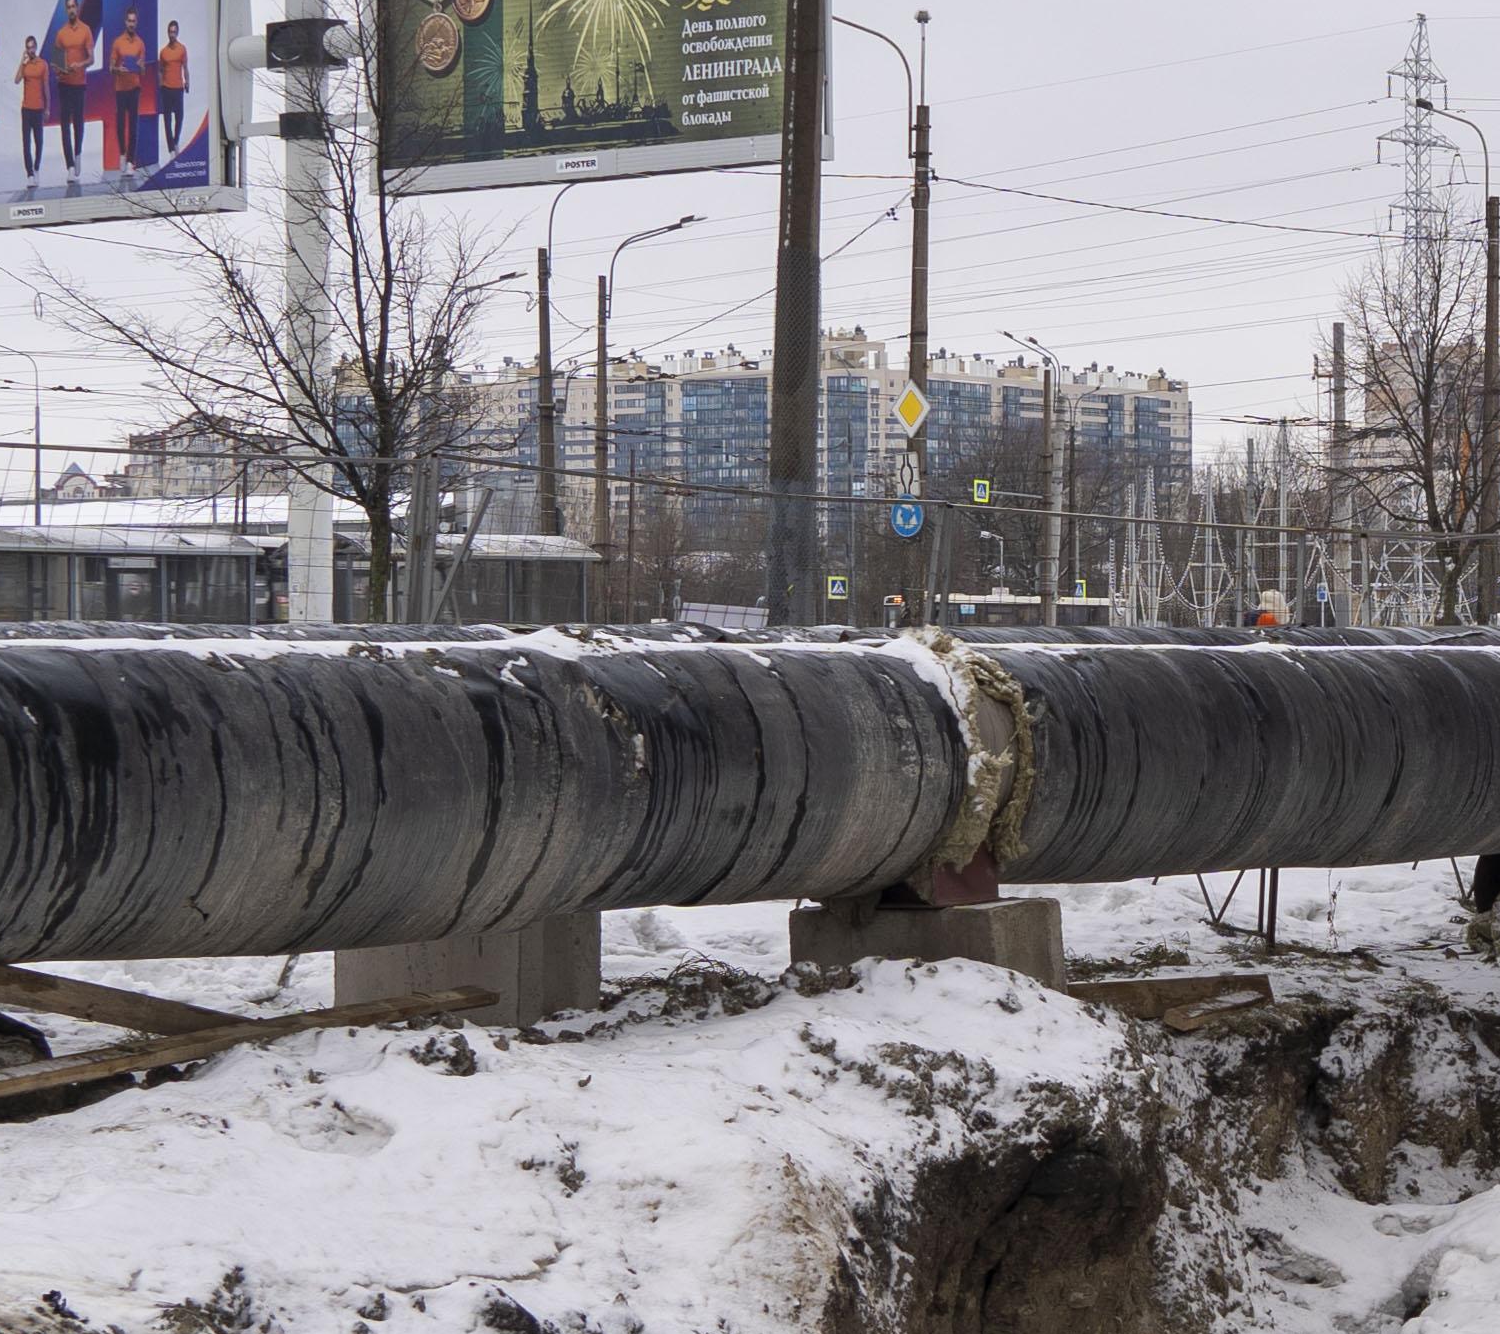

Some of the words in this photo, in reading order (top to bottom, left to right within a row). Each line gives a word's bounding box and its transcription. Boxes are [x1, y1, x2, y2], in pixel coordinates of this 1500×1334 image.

[682, 19, 713, 38] День
[715, 14, 767, 31] полного
[682, 34, 773, 54] освобождения
[682, 56, 783, 82] ЛЕНИНГРАДА
[682, 94, 695, 105] от
[697, 83, 770, 107] фашистской
[682, 111, 731, 126] блокады
[565, 159, 596, 169] POSTER
[17, 208, 44, 216] POSTER
